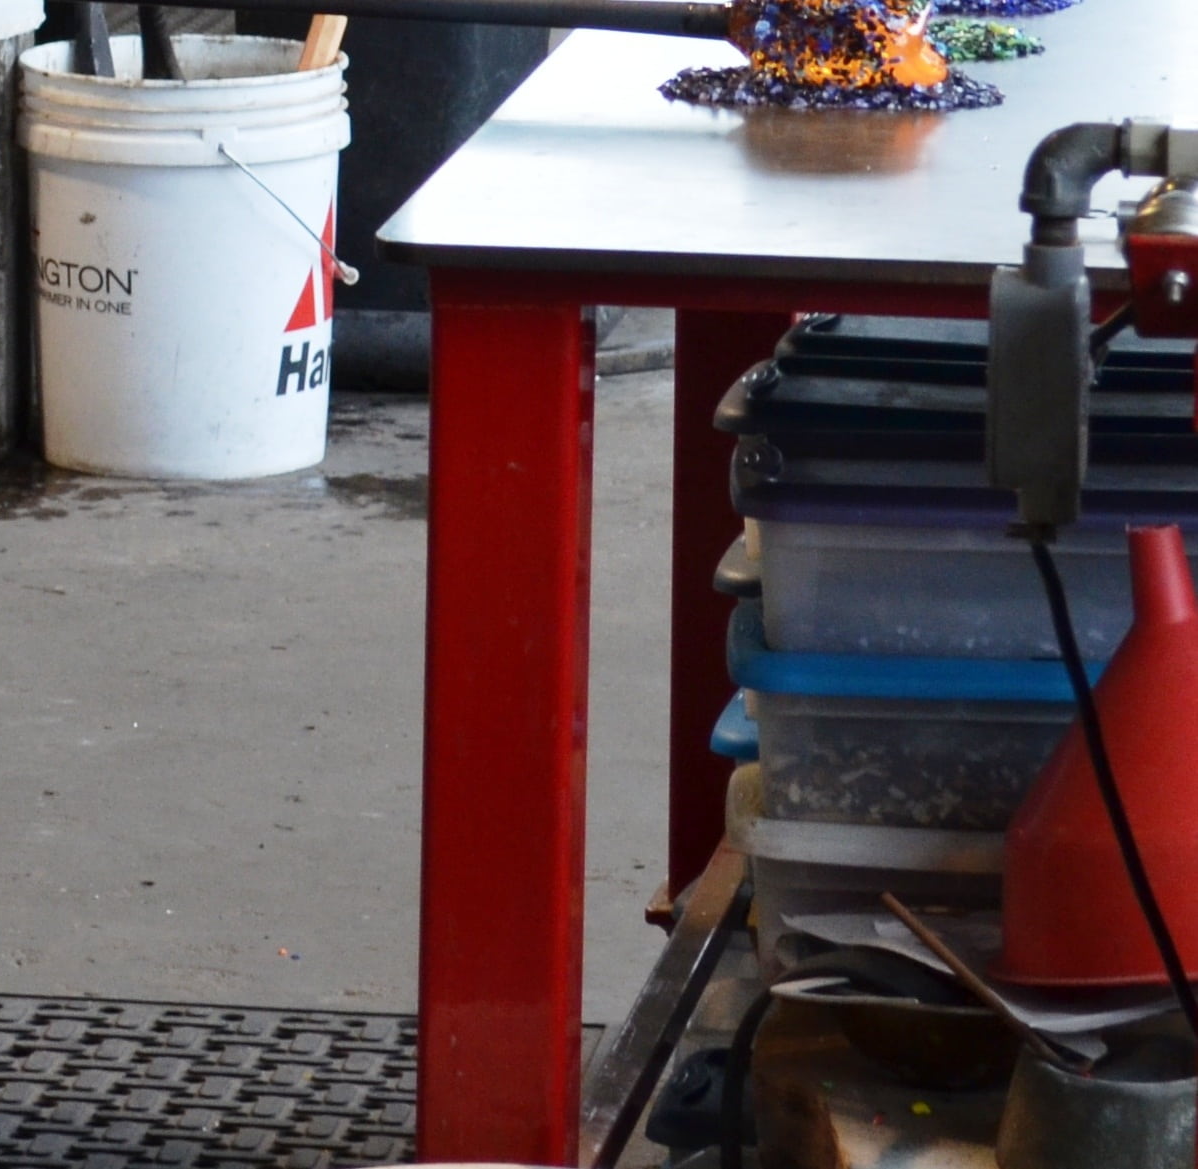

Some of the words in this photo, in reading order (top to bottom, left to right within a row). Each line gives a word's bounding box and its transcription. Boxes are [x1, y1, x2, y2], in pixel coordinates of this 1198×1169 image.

[76, 297, 90, 311] IN
[94, 299, 132, 316] ONE
[276, 340, 331, 396] Ha
